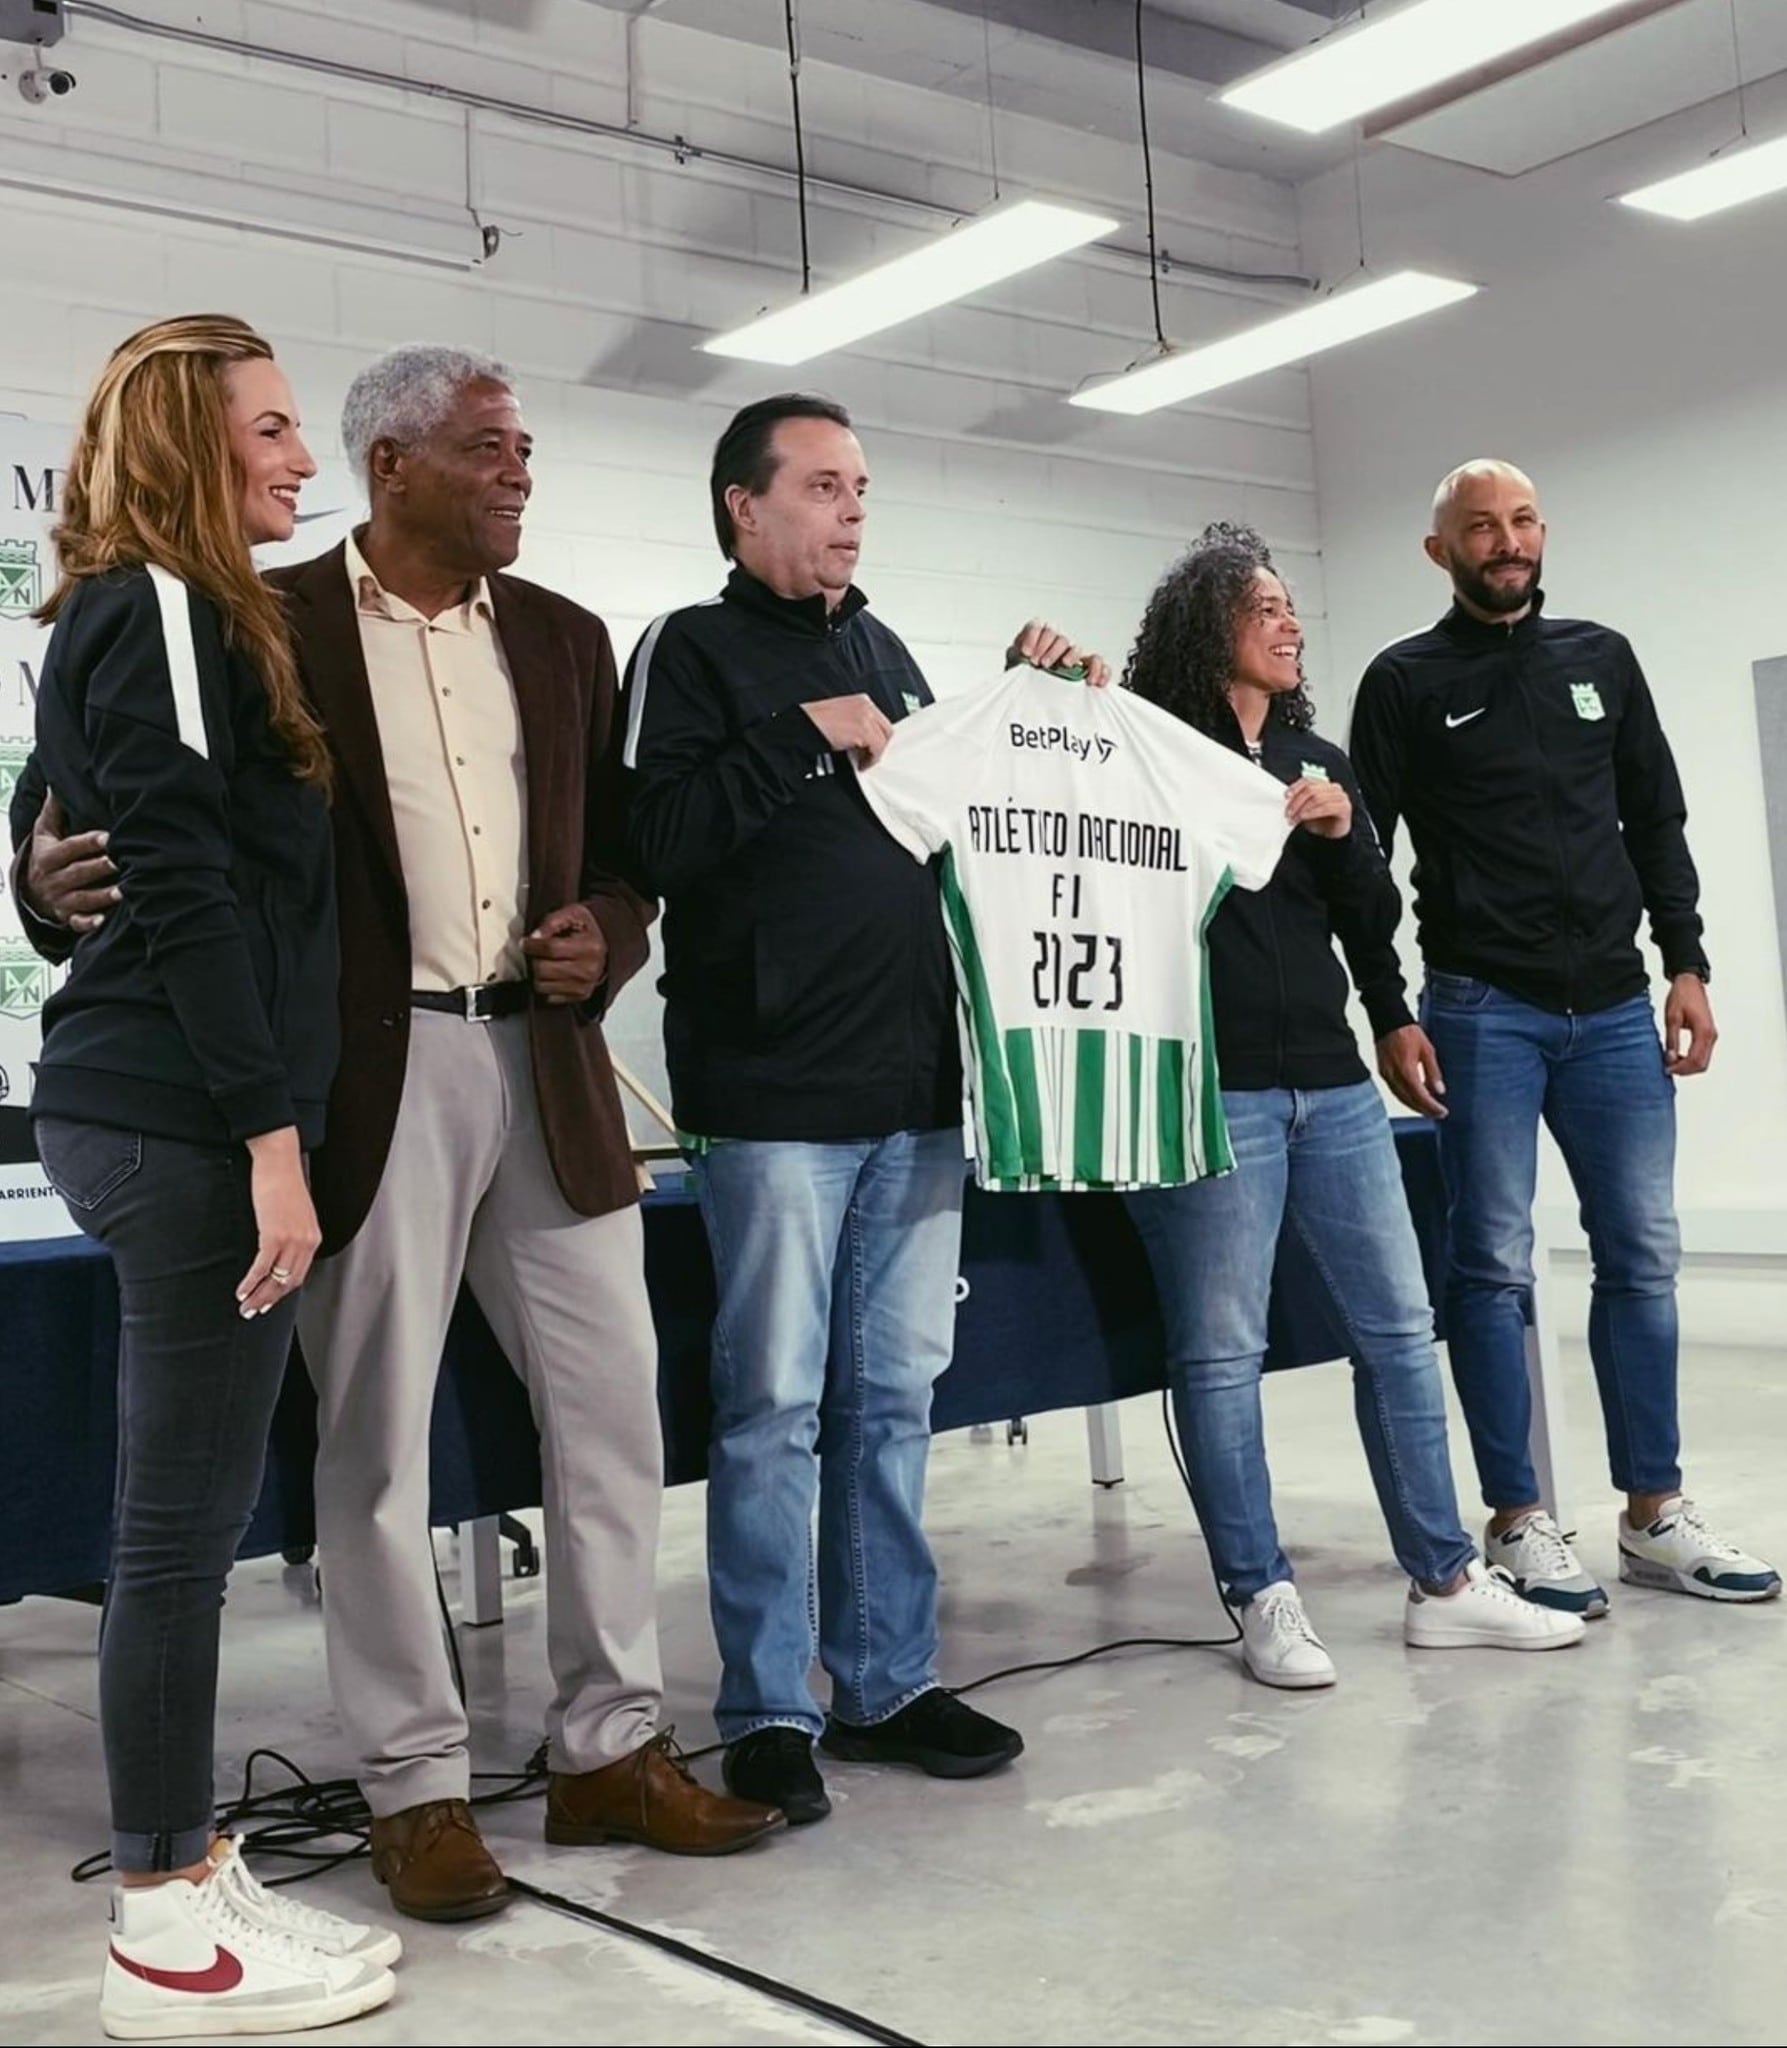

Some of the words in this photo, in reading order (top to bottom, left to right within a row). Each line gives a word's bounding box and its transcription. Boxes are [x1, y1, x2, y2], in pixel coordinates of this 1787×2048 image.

[1010, 722, 1091, 762] BetPlay
[968, 796, 1068, 858] ATLÉTICO
[1078, 812, 1188, 872] NACIONAL
